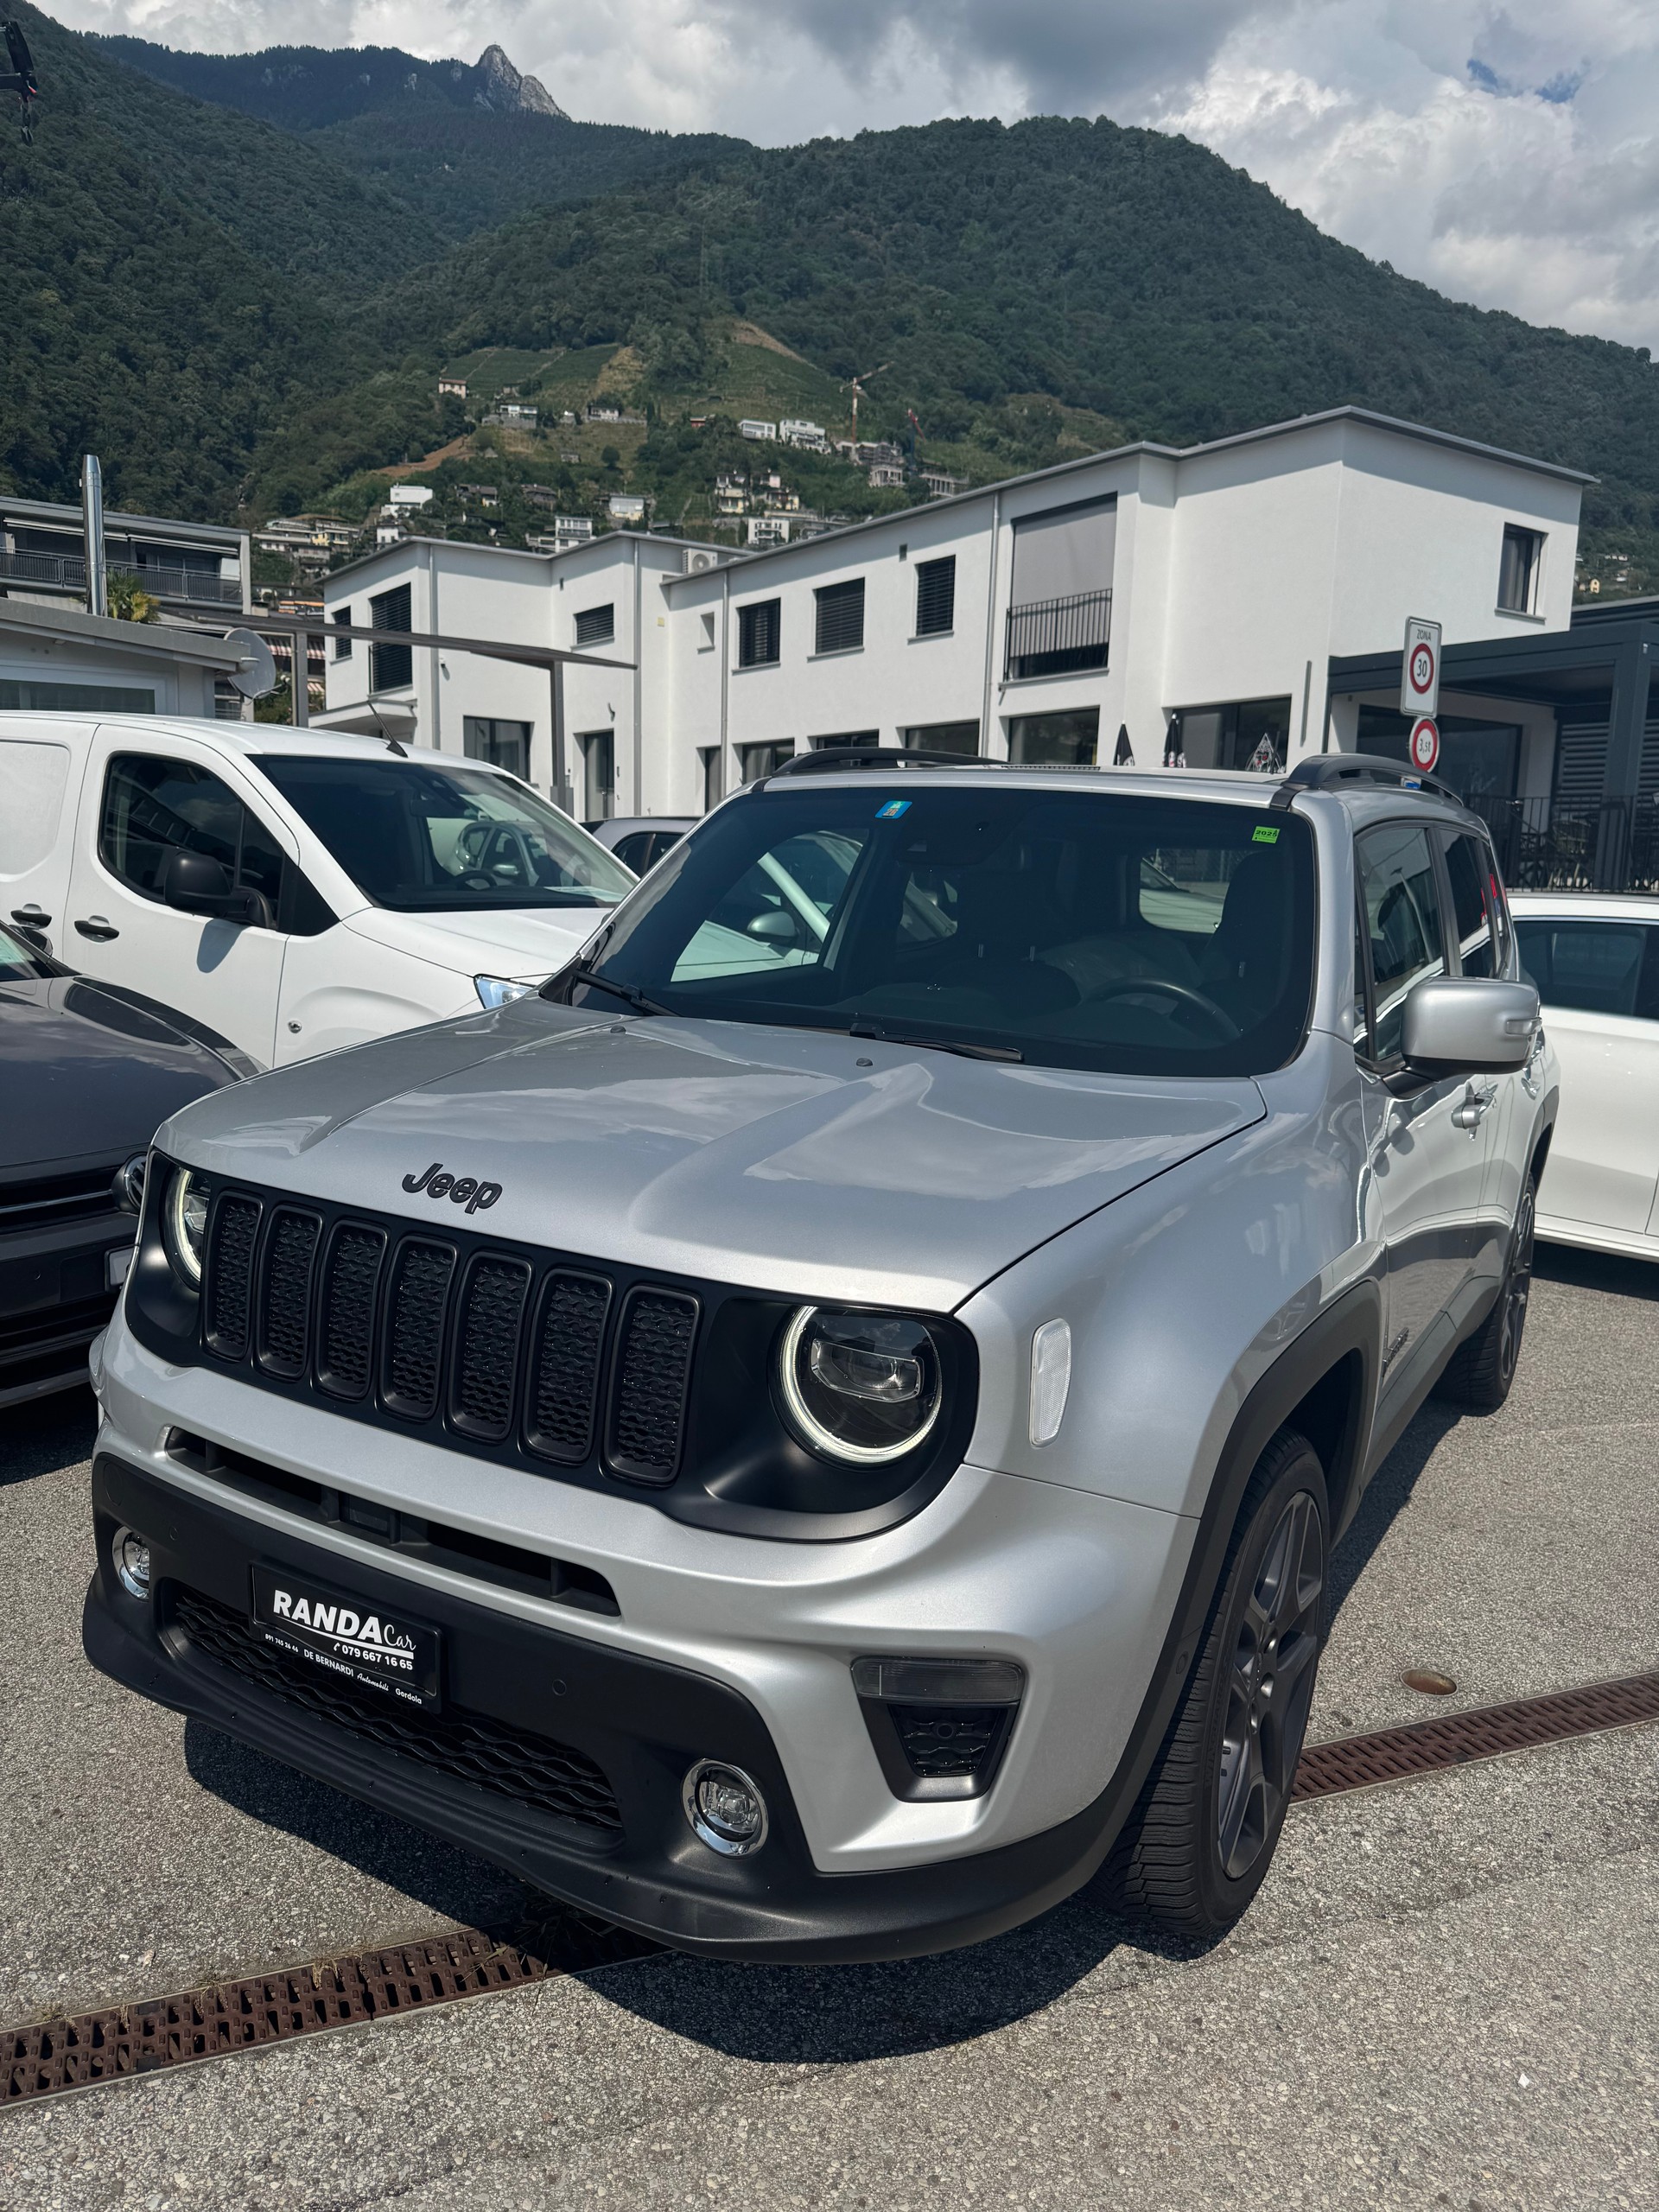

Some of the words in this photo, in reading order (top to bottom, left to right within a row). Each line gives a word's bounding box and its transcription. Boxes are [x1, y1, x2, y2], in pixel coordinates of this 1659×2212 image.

[1417, 629, 1432, 641] ZONA
[1417, 658, 1427, 677] 30
[402, 1163, 503, 1215] Jeep
[273, 1589, 383, 1643] RANDA
[384, 1624, 416, 1650] Car
[341, 1645, 361, 1657] 079
[363, 1650, 382, 1662] 667
[385, 1656, 397, 1667] 16
[399, 1659, 413, 1670] 65
[303, 1649, 314, 1660] DE
[315, 1654, 354, 1677] BERNARDI
[357, 1673, 389, 1691] Automobili
[395, 1688, 423, 1705] Gordola
